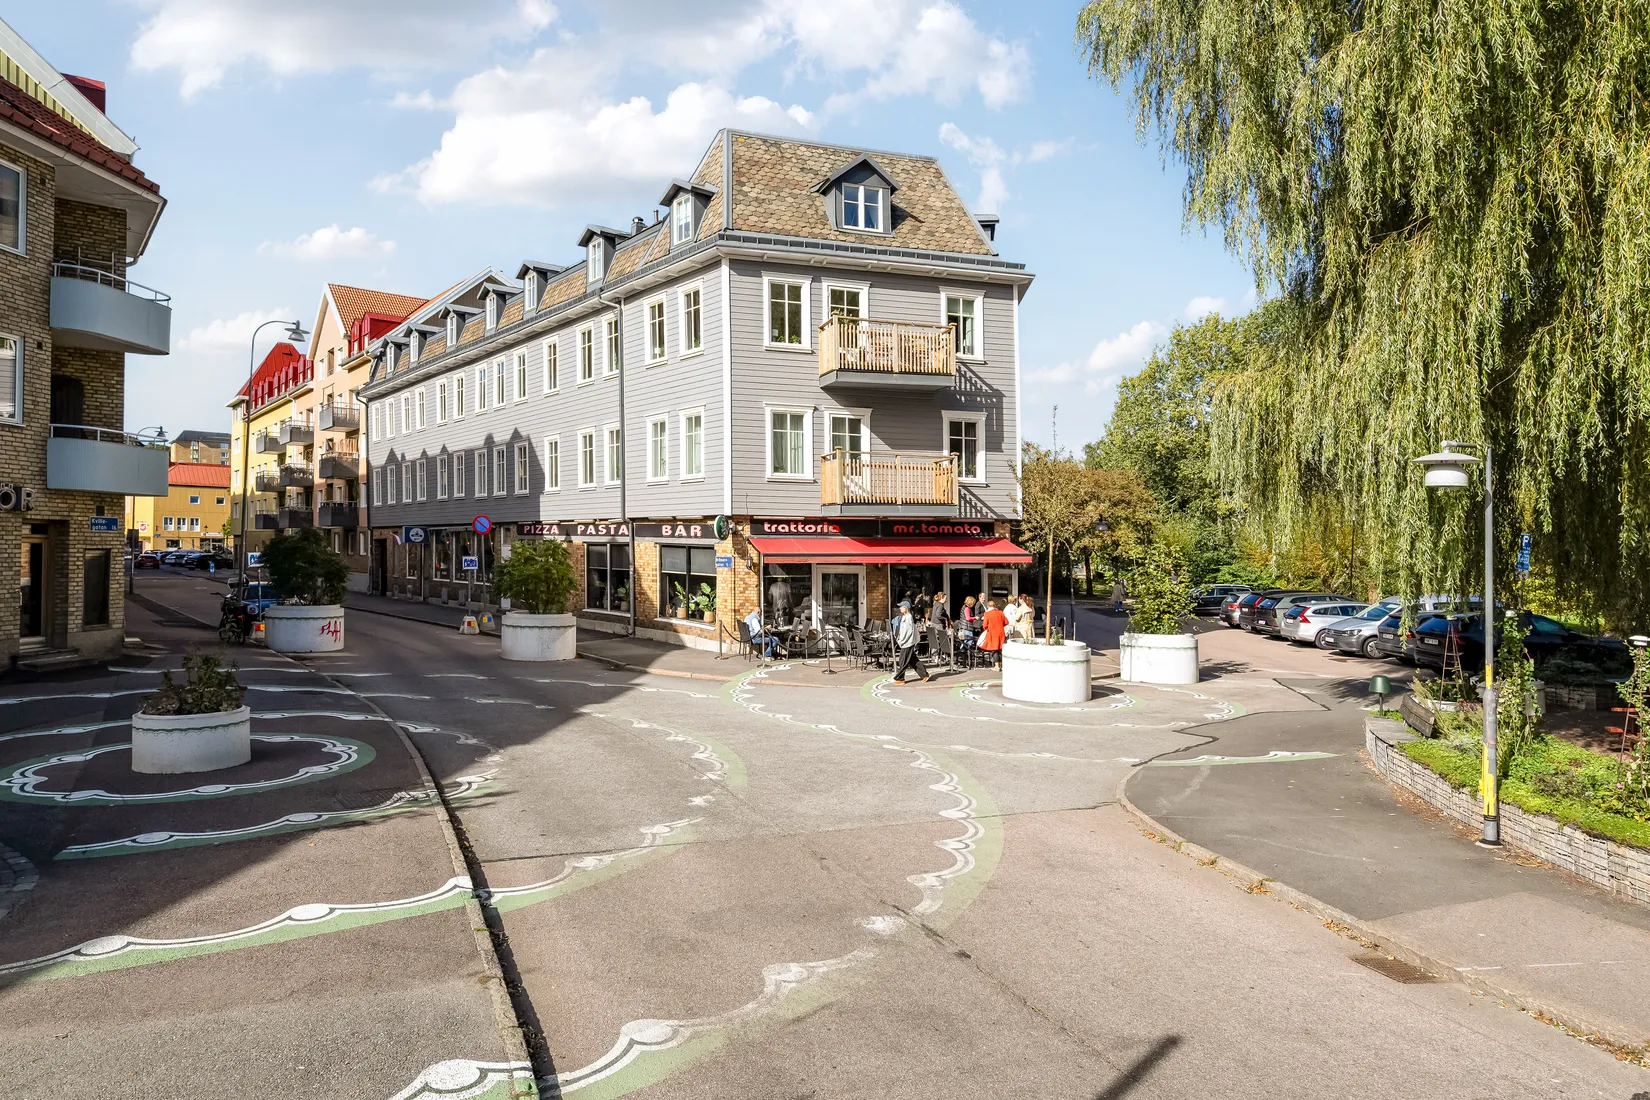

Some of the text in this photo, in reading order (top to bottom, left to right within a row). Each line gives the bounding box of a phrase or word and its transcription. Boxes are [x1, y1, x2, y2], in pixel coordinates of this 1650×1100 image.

[523, 524, 560, 535] PIZZA
[577, 524, 629, 536] PASTA
[661, 524, 702, 537] BAR
[763, 521, 841, 533] trattoria
